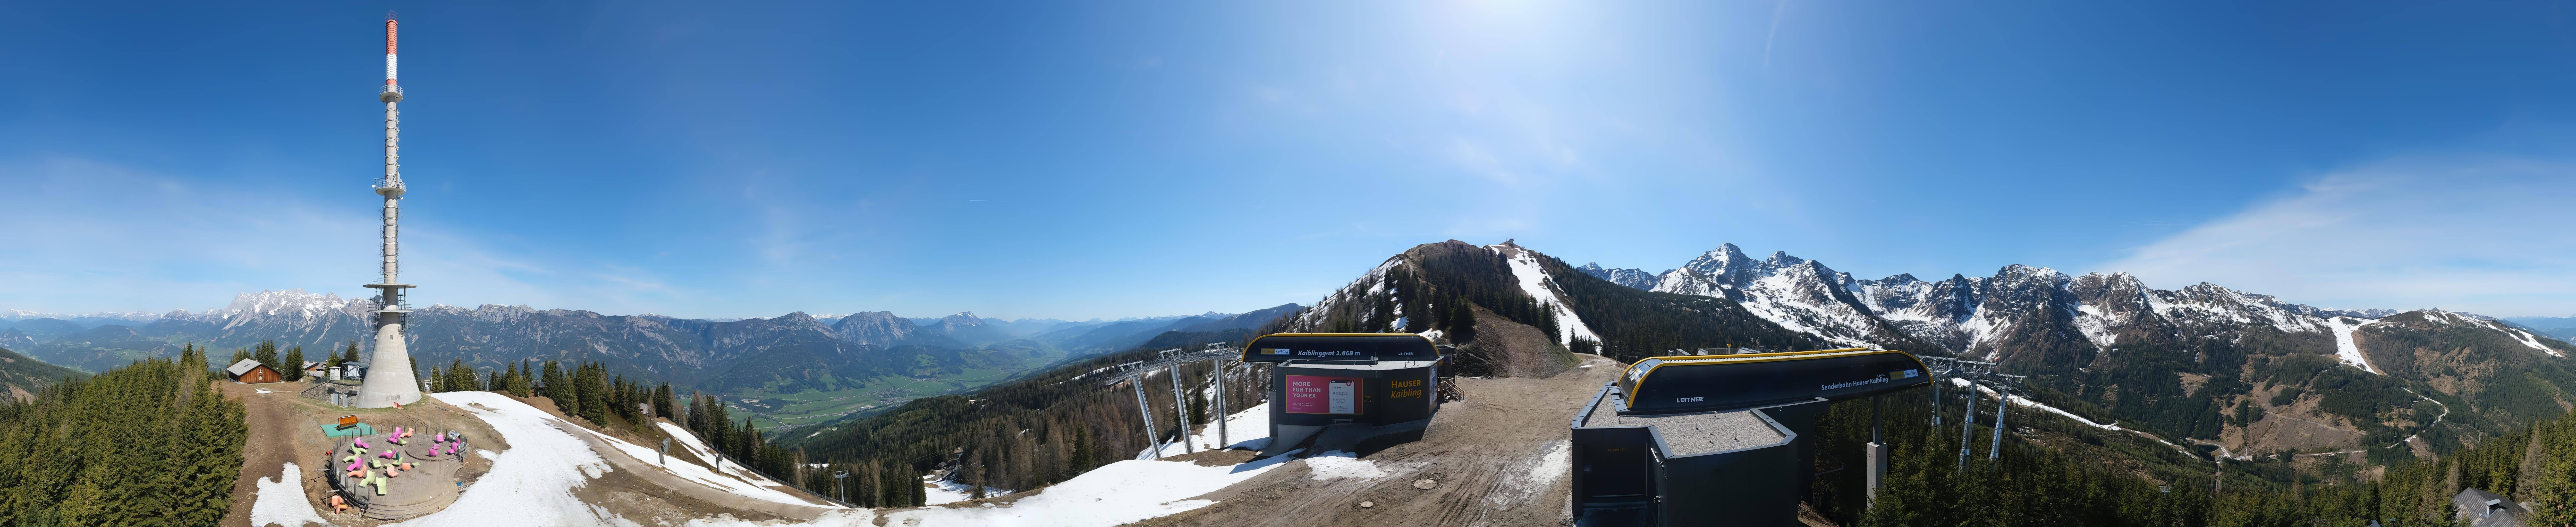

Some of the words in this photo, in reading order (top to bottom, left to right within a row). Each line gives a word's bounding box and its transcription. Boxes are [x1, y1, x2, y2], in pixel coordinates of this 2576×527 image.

[1391, 380, 1421, 388] HAUSER
[1821, 381, 1852, 390] Senderbahn
[1391, 388, 1421, 398] Kaibling
